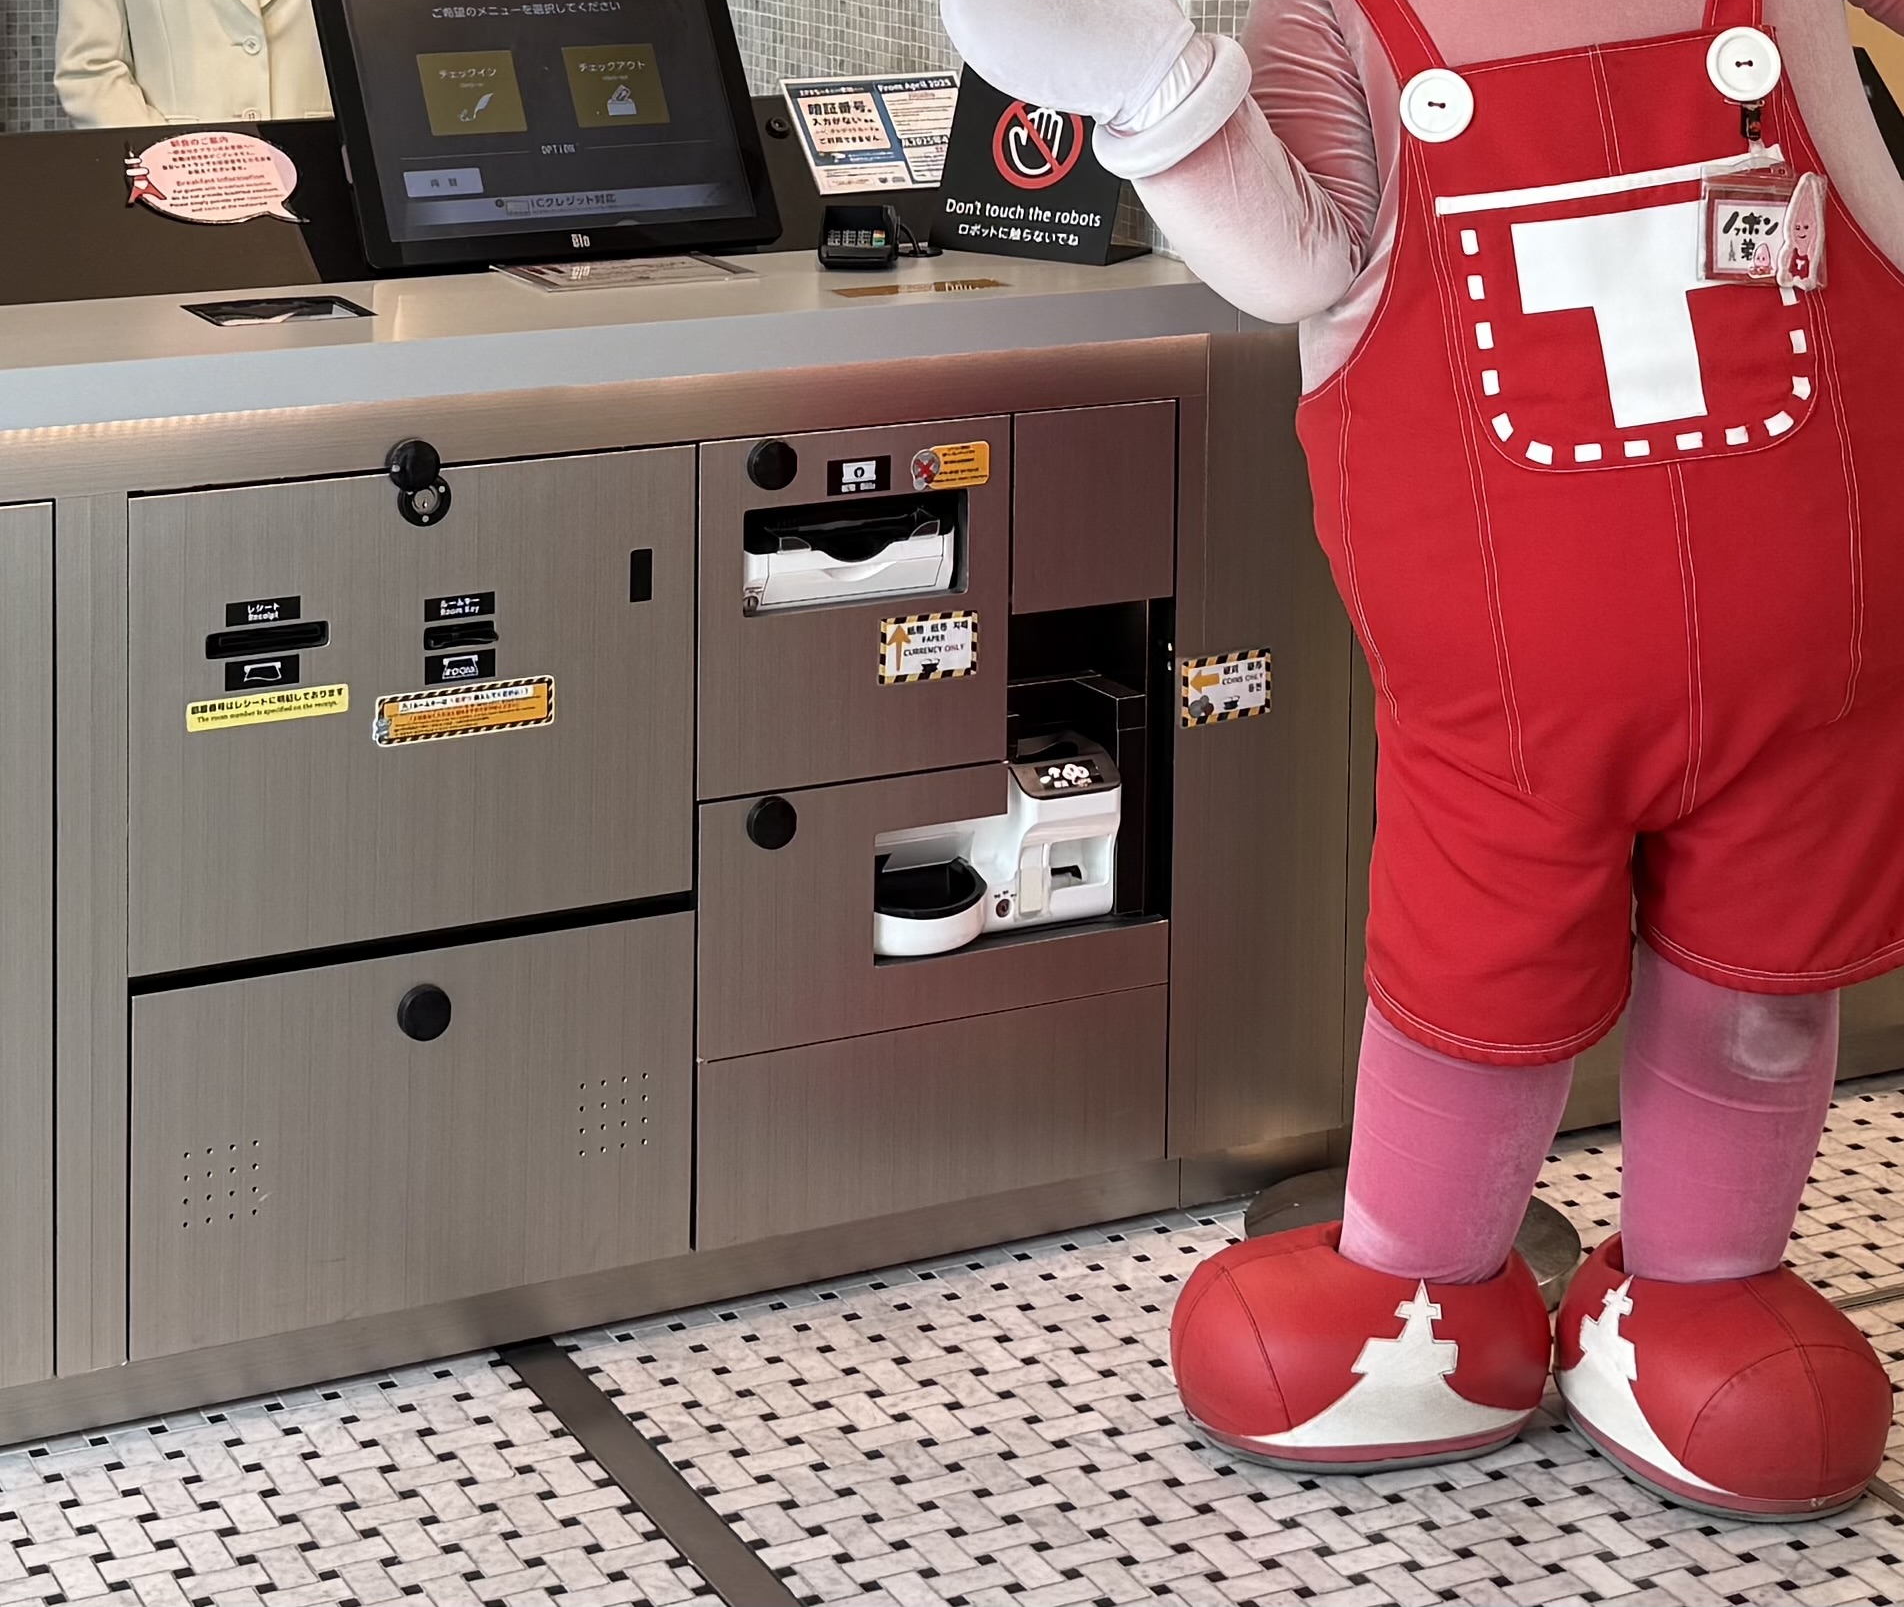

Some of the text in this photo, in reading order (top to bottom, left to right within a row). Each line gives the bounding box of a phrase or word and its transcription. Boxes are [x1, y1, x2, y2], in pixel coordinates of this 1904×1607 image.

[578, 61, 646, 73] チェックアウト
[877, 83, 904, 93] From
[905, 80, 928, 92] April
[945, 198, 1101, 227] Don't touch the robots
[958, 223, 1080, 246] ロボットに触らないでね
[247, 602, 280, 614] レシート
